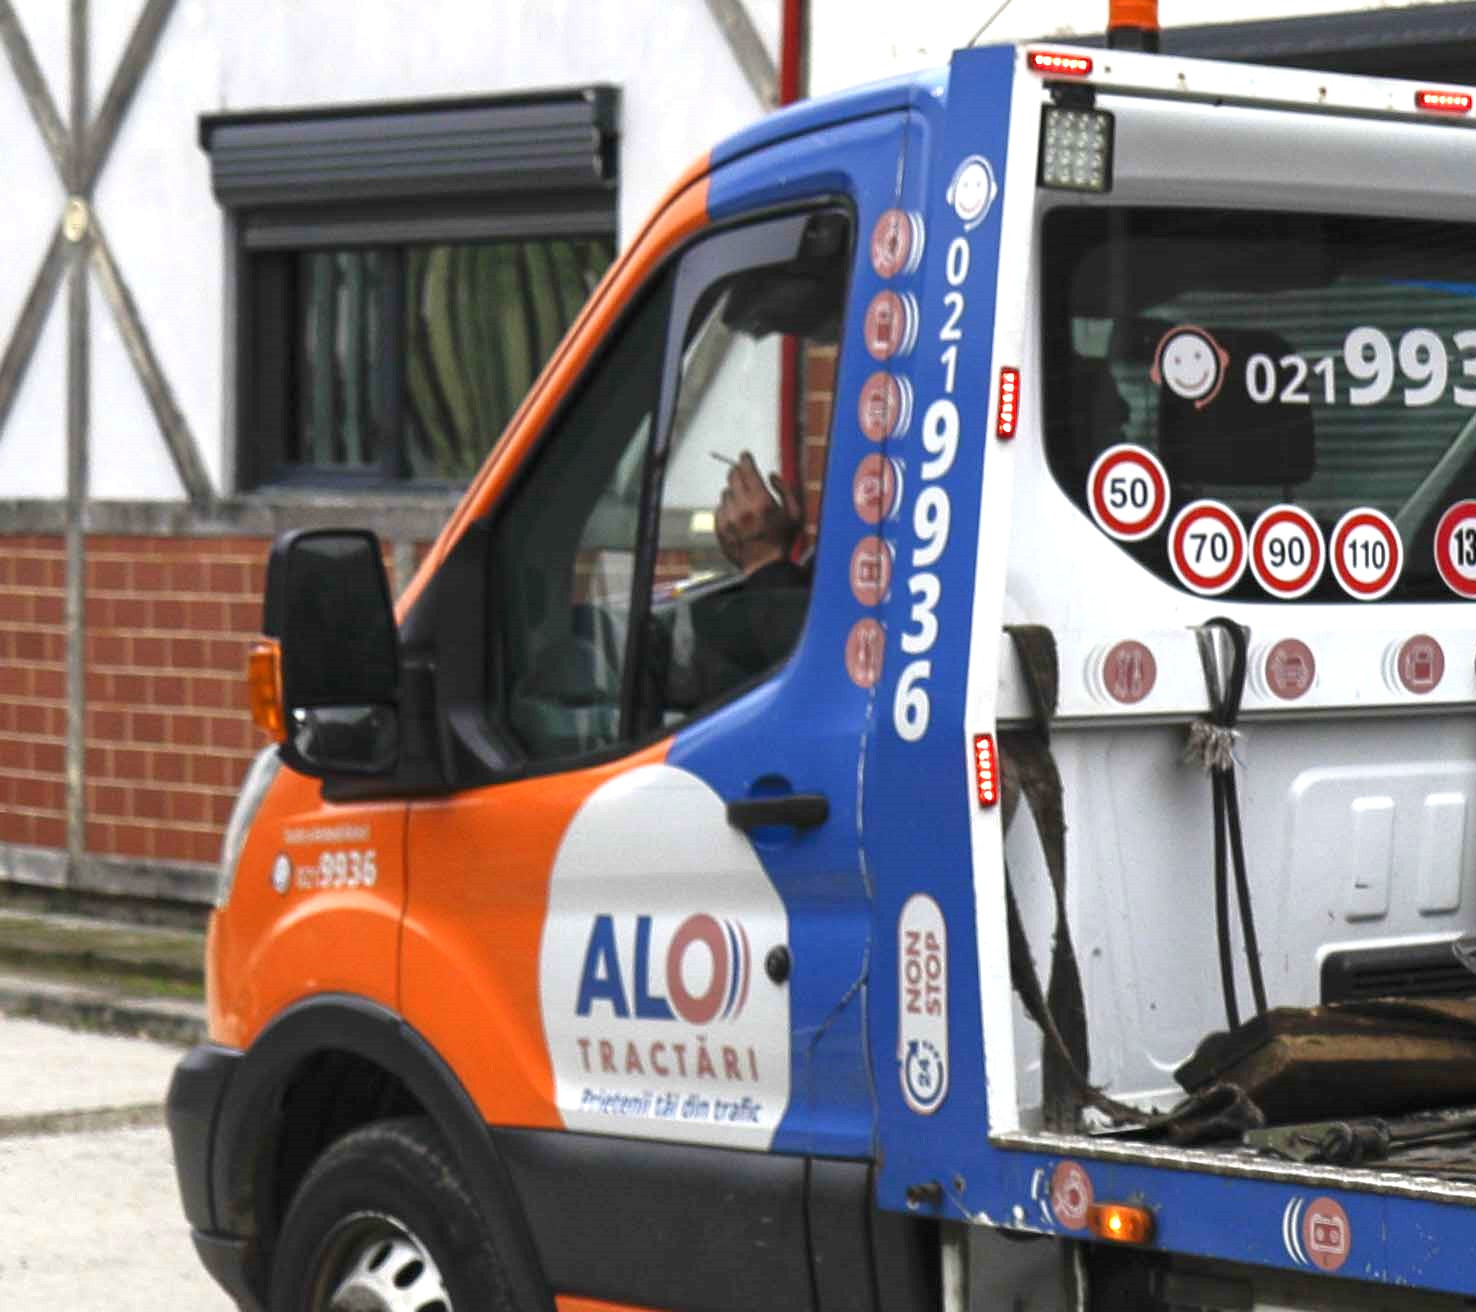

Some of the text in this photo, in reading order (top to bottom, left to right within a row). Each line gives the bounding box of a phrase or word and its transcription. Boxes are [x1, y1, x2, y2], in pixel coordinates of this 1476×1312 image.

[1109, 477, 1148, 509] 50
[1189, 531, 1228, 564] 70
[1268, 535, 1305, 568] 90
[1348, 538, 1386, 570] 110
[575, 912, 730, 1027] ALO
[905, 930, 922, 1015] NON
[925, 931, 942, 1017] STOP
[577, 1033, 760, 1083] TRACTĂRI
[917, 1058, 932, 1088] 24
